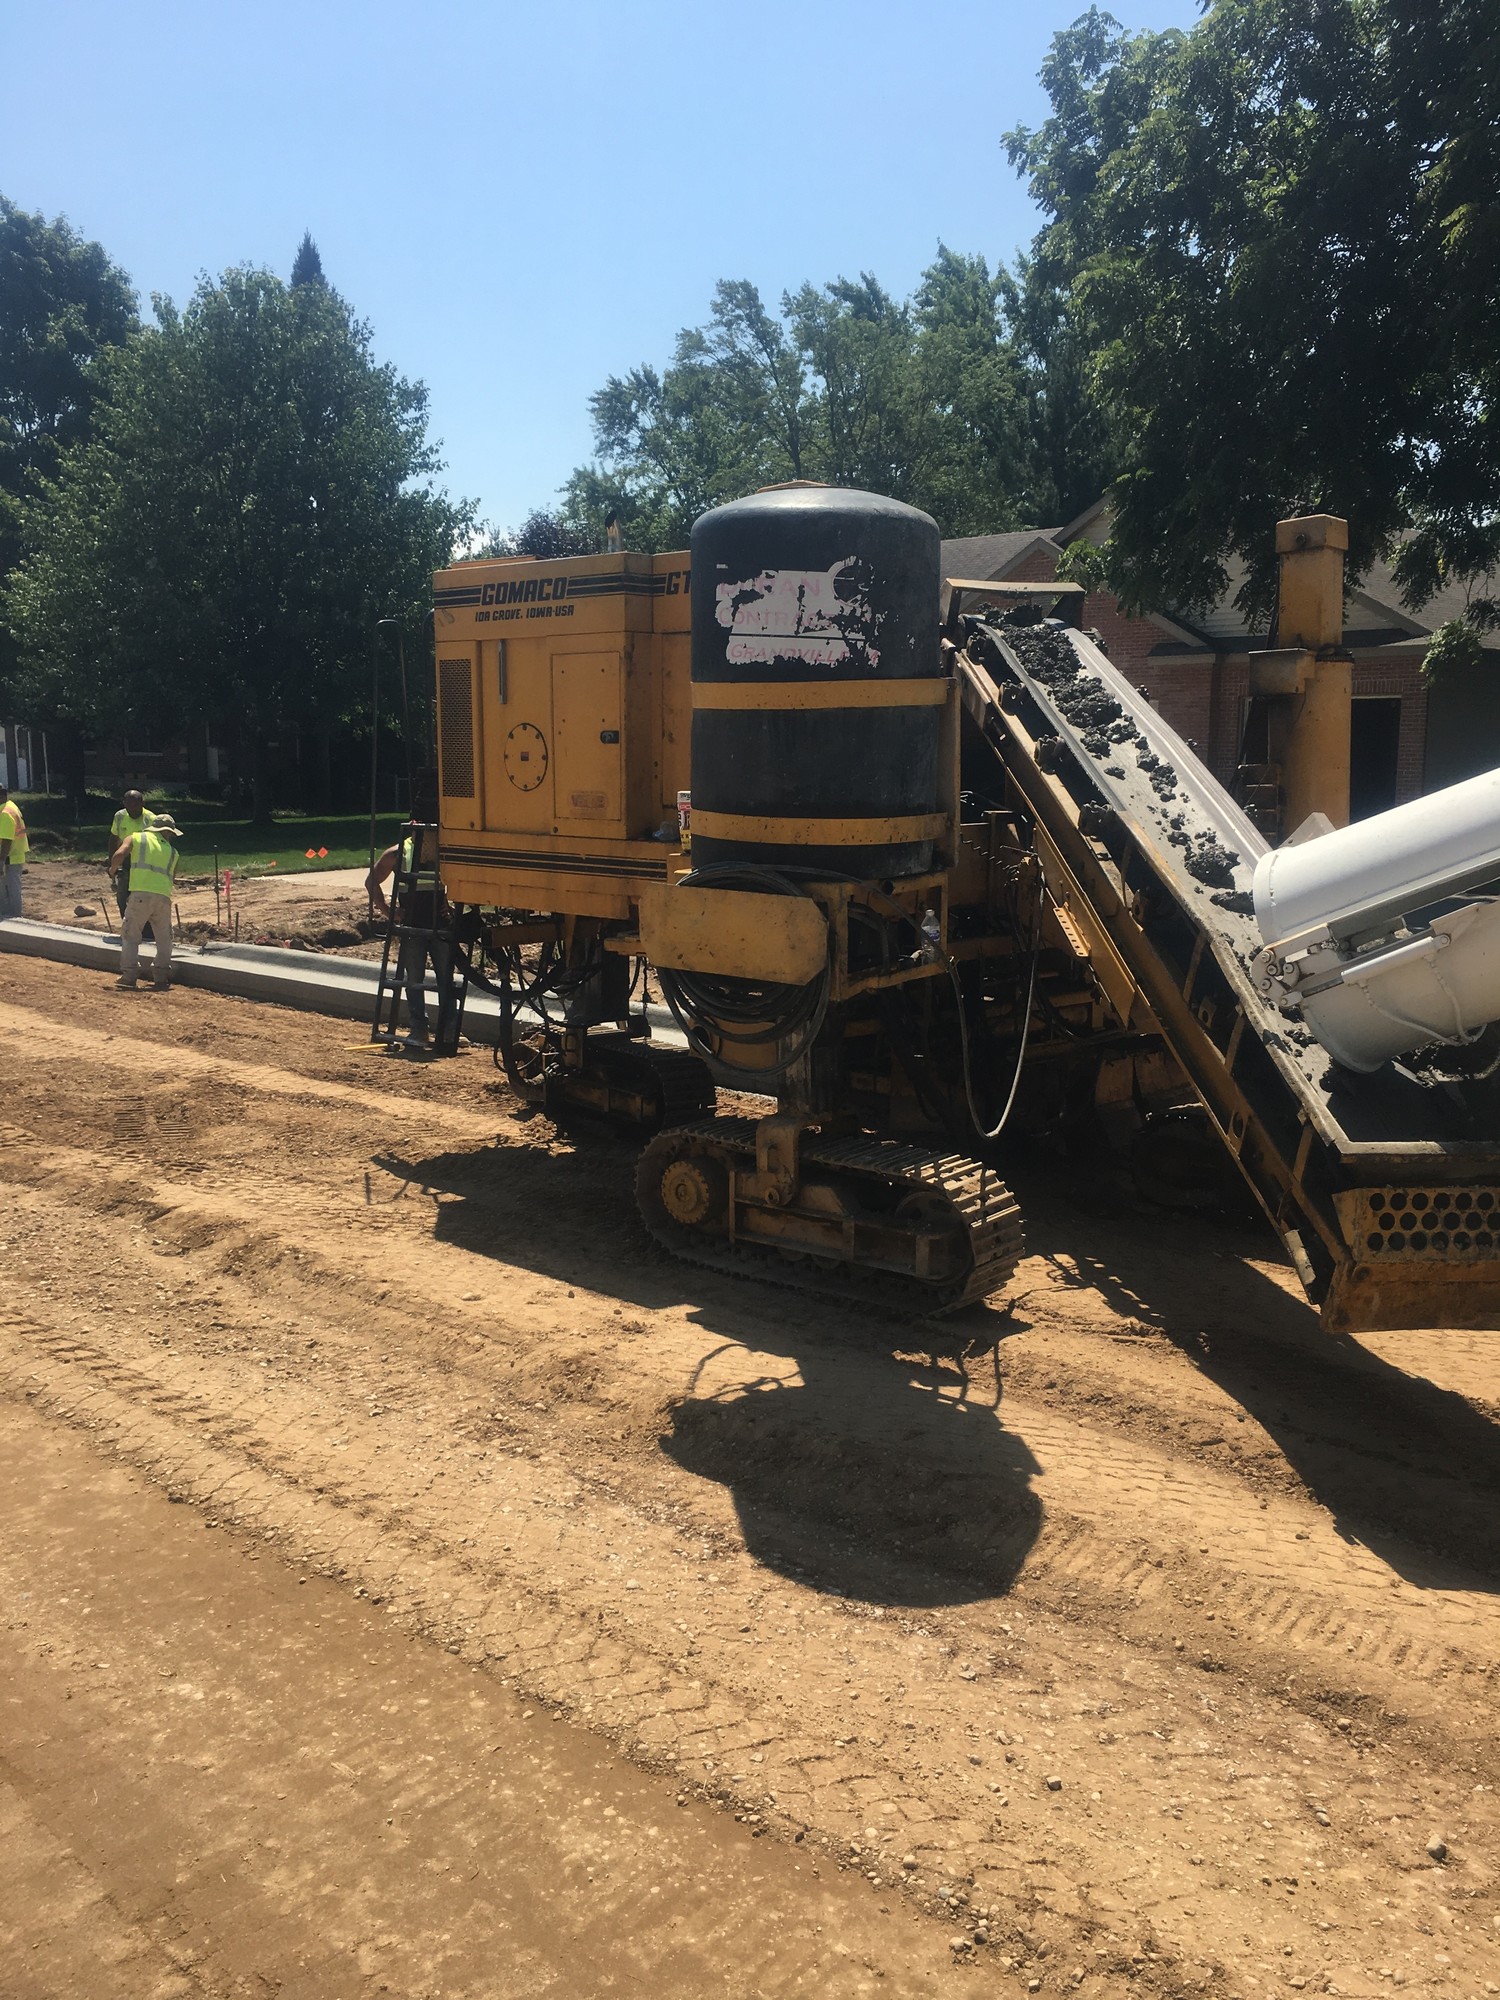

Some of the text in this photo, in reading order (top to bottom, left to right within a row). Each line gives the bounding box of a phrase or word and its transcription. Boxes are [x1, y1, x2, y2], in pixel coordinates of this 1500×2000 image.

[481, 577, 567, 606] GOMACO
[475, 611, 490, 622] IDA
[492, 609, 523, 621] GROVE,
